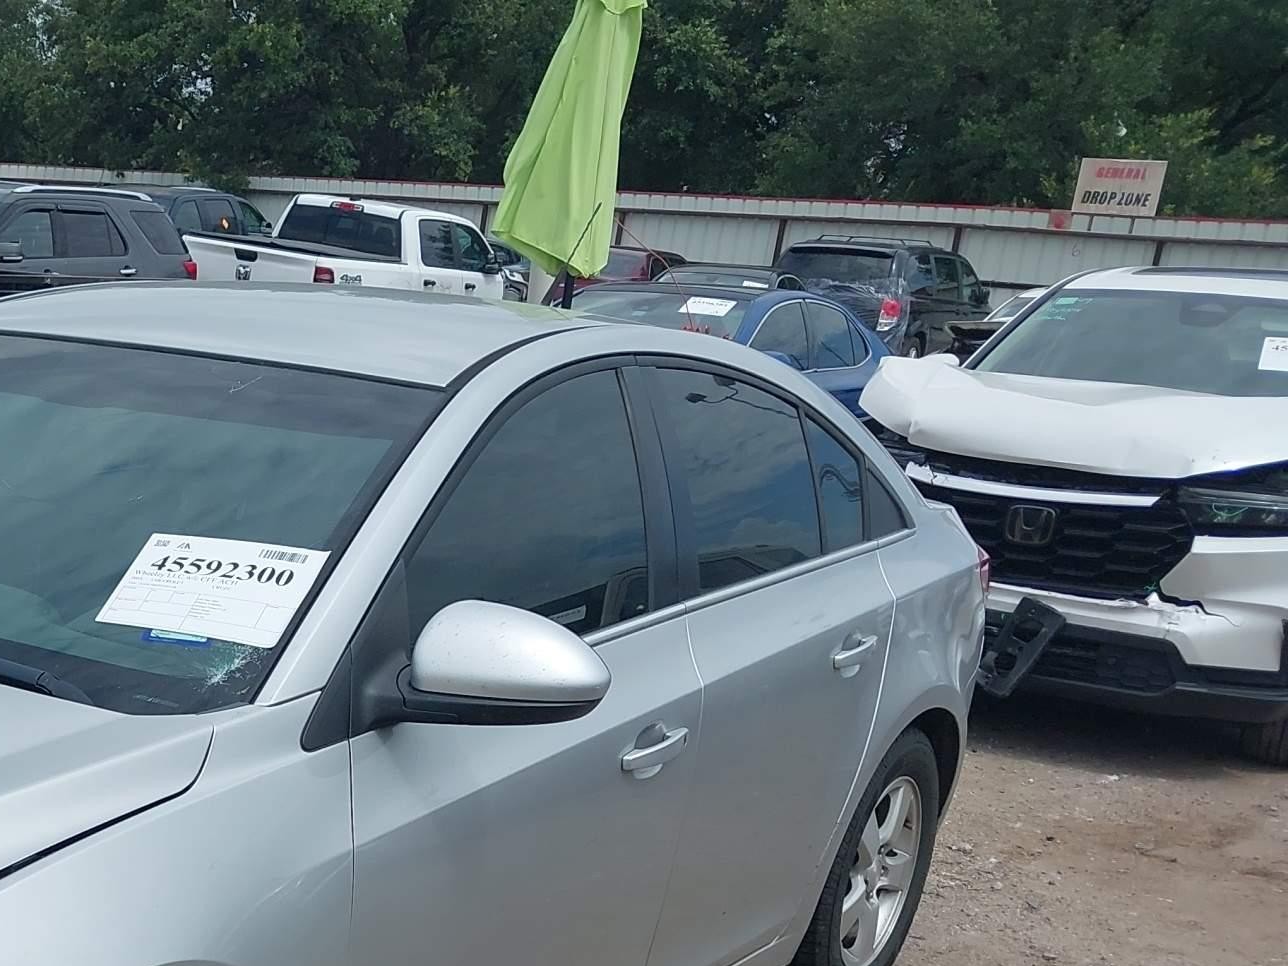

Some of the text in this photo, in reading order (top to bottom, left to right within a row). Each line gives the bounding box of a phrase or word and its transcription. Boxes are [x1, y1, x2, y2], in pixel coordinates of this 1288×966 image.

[1081, 190, 1151, 207] DROP ZONE
[150, 555, 295, 587] 45592300
